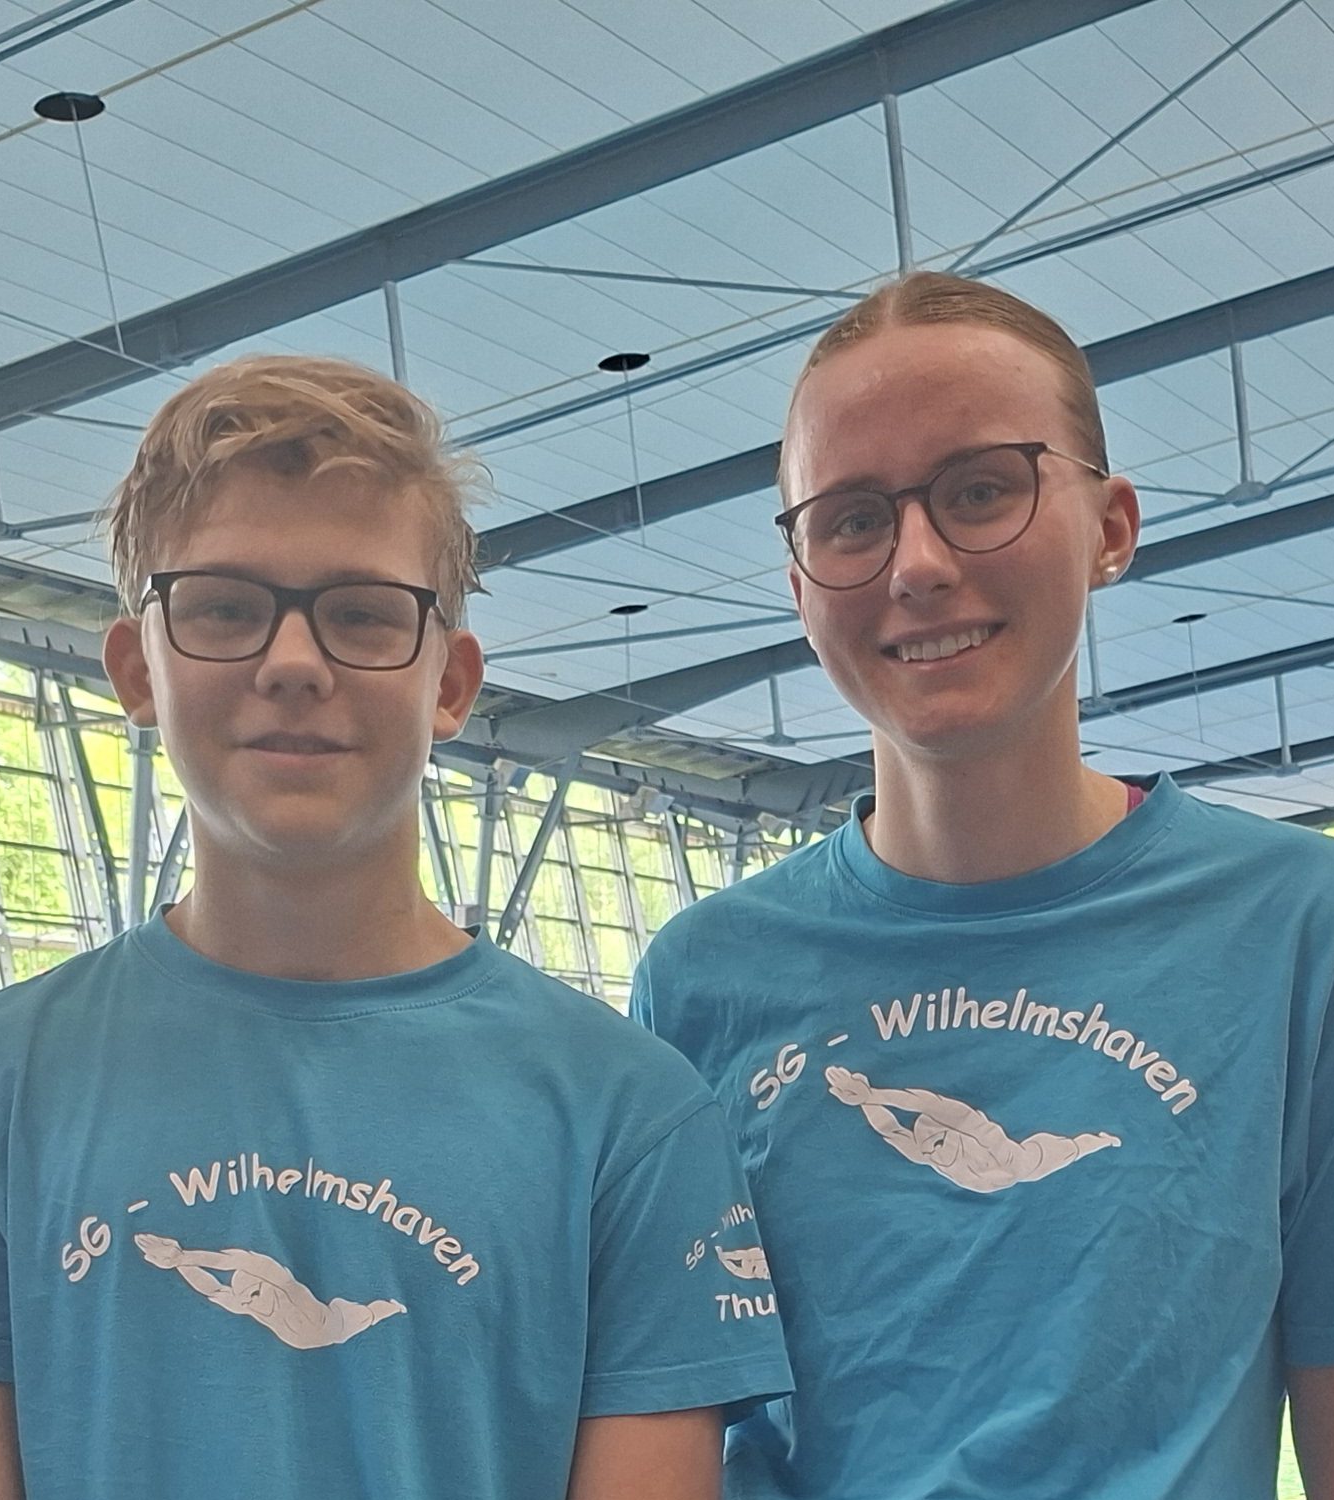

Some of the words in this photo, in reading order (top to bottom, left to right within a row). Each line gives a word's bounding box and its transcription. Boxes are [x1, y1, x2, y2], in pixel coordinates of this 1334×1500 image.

[748, 1043, 807, 1110] SG
[871, 986, 1198, 1115] Wilhelmshaven
[62, 1215, 112, 1282] SG
[170, 1152, 481, 1285] Wilhelmshaven
[685, 1239, 705, 1271] SG
